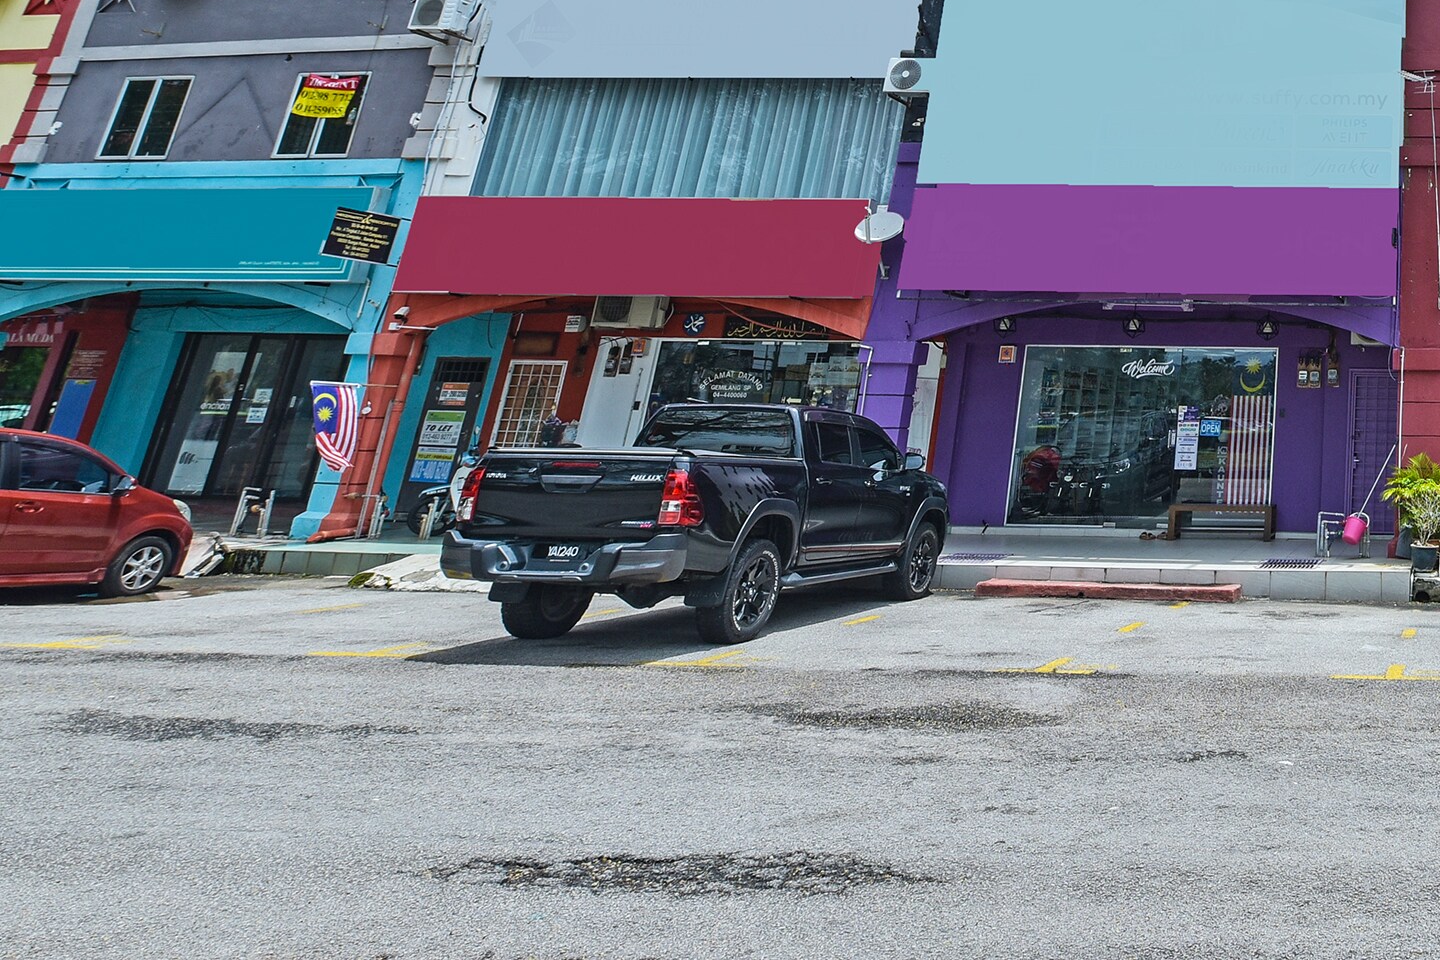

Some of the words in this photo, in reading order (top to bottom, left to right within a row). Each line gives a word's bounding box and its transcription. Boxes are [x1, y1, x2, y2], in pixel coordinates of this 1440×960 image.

[1121, 358, 1175, 378] Welcome
[699, 370, 736, 390] SELAMAT
[737, 371, 764, 391] DATANG
[425, 424, 438, 432] TO
[438, 424, 454, 432] LET
[1201, 423, 1220, 433] OPEN
[630, 474, 663, 482] HILUX
